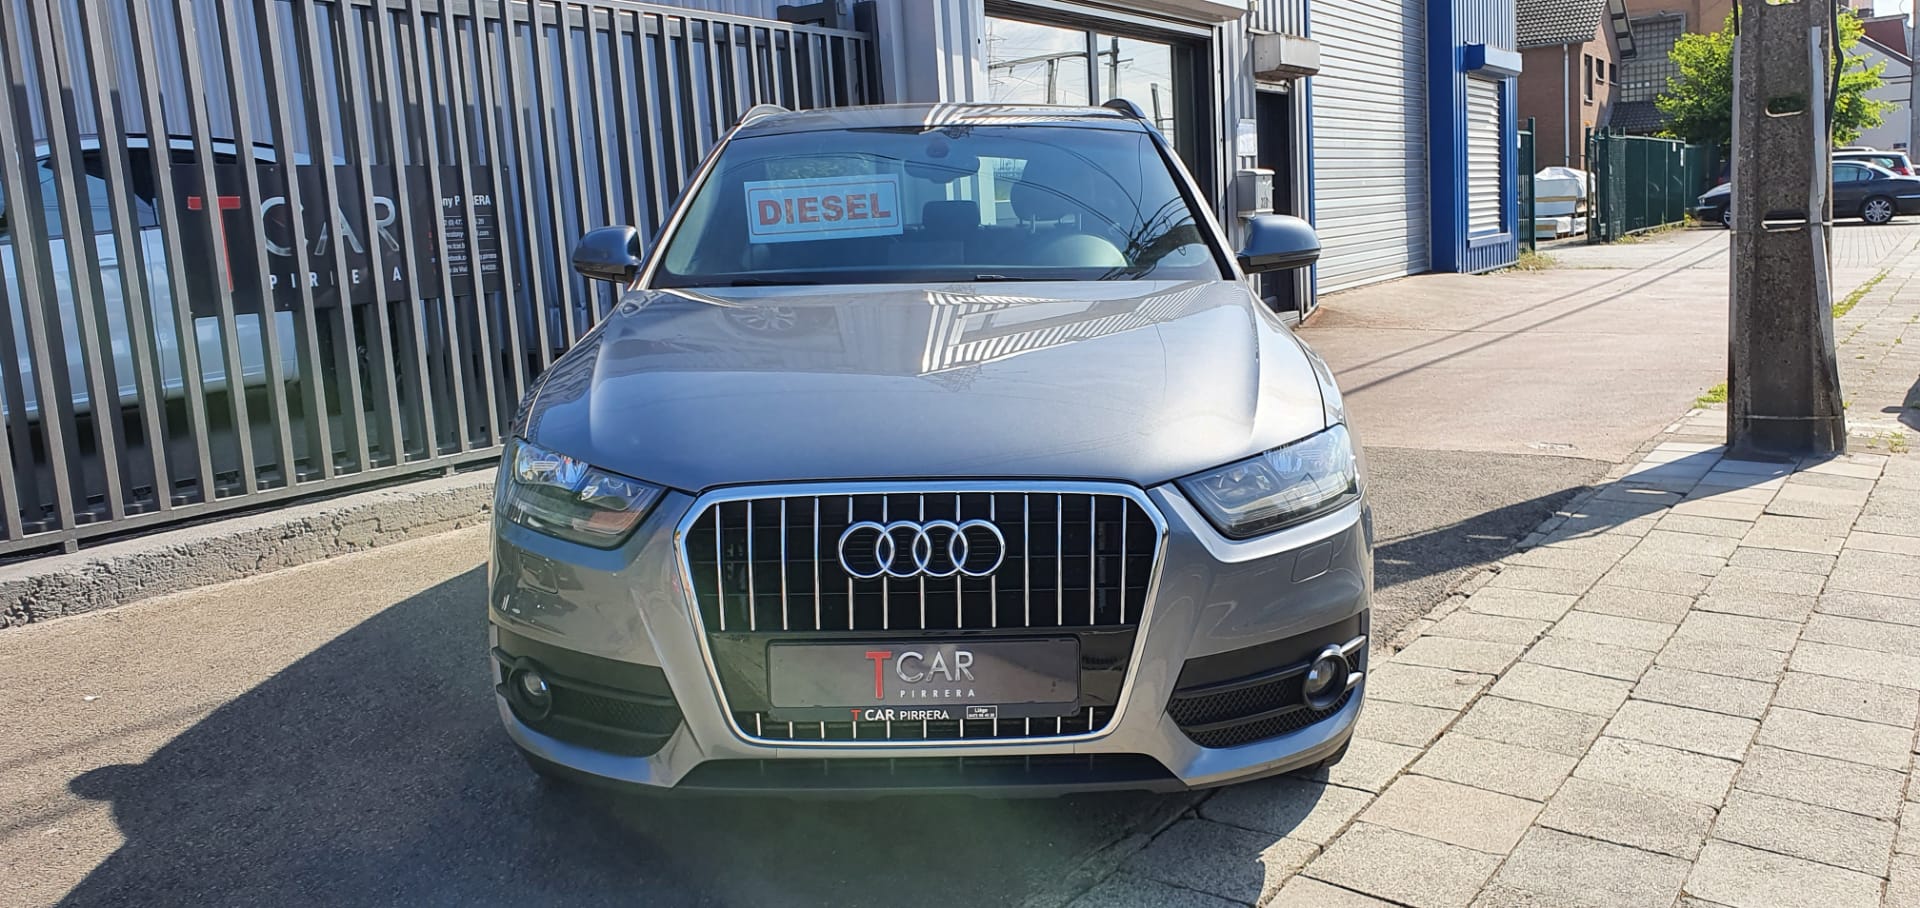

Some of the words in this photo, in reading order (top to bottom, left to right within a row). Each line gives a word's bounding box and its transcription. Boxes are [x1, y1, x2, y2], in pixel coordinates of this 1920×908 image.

[757, 192, 891, 226] DIESEL
[865, 651, 892, 699] T
[896, 650, 974, 682] CAR
[900, 688, 976, 698] PIRRERA
[851, 709, 861, 720] T
[864, 709, 895, 721] CAR
[900, 710, 949, 720] PIRRERA
